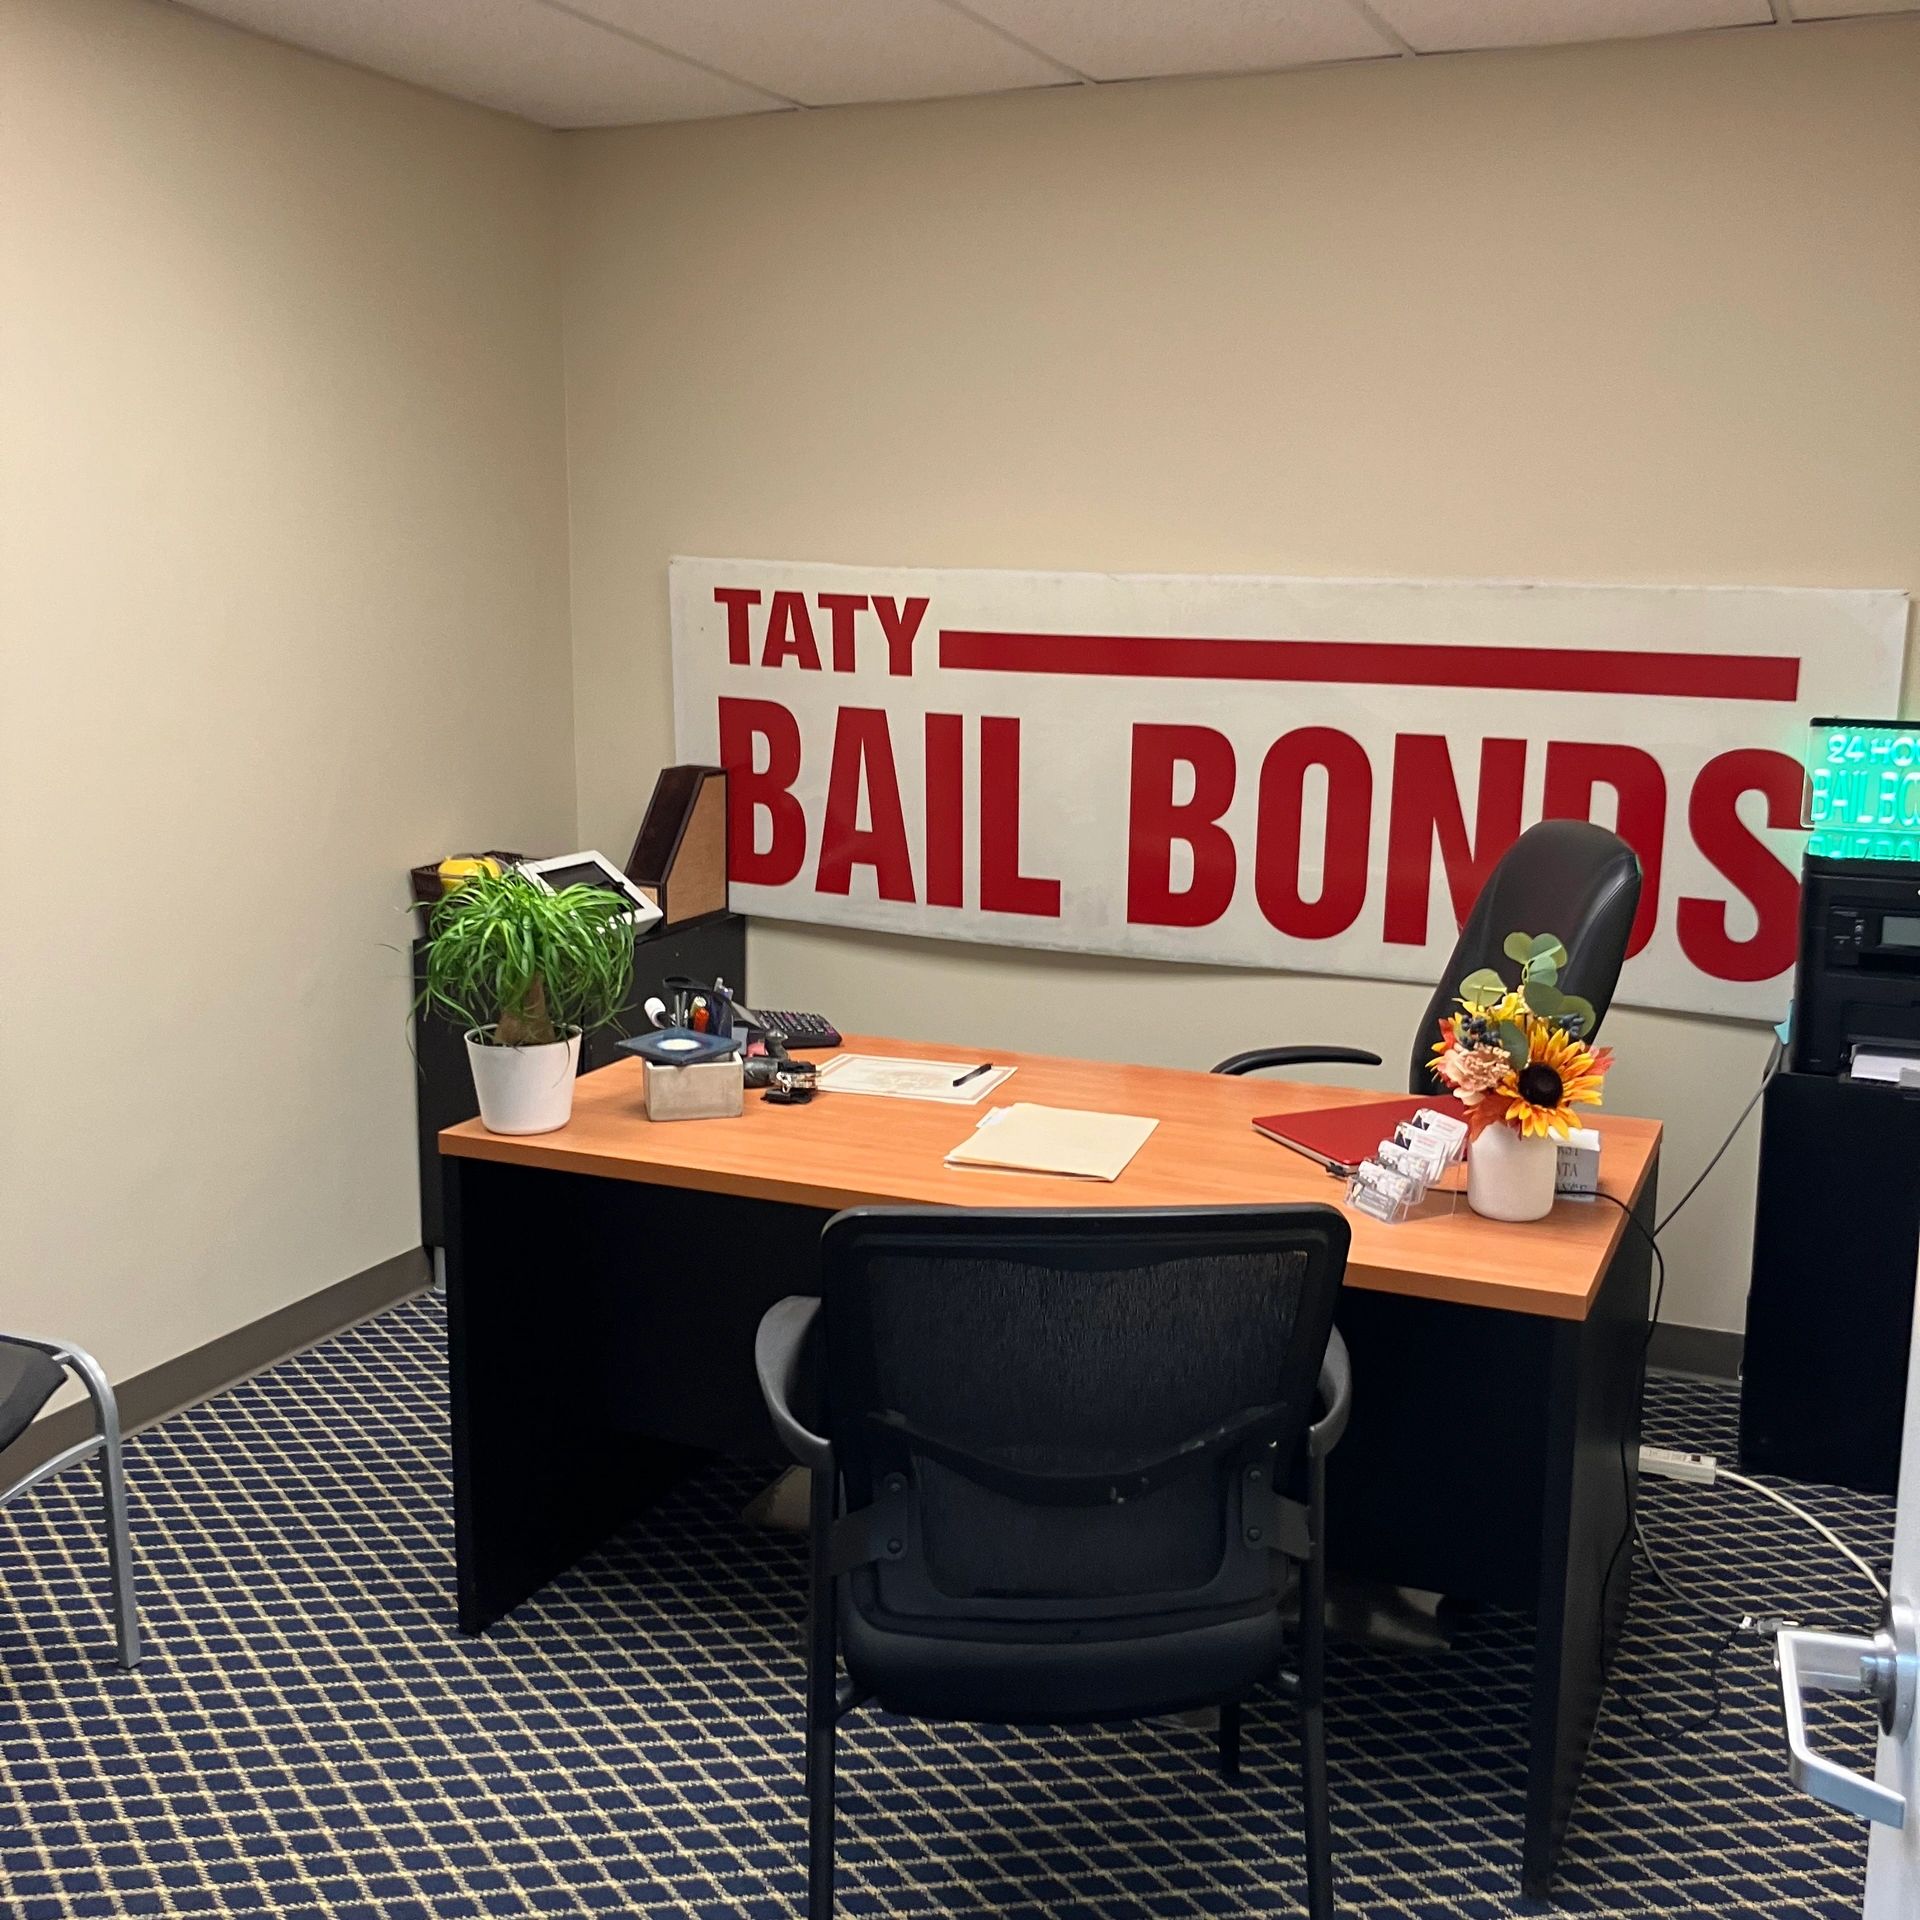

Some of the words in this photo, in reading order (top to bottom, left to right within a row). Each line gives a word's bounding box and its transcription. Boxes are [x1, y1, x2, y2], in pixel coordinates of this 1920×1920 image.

[714, 587, 930, 677] TATY
[1827, 734, 1865, 763] 24
[1869, 736, 1920, 767] HO
[718, 696, 1061, 918] BAIL
[1811, 768, 1873, 824] BAIL
[1878, 771, 1920, 826] BO
